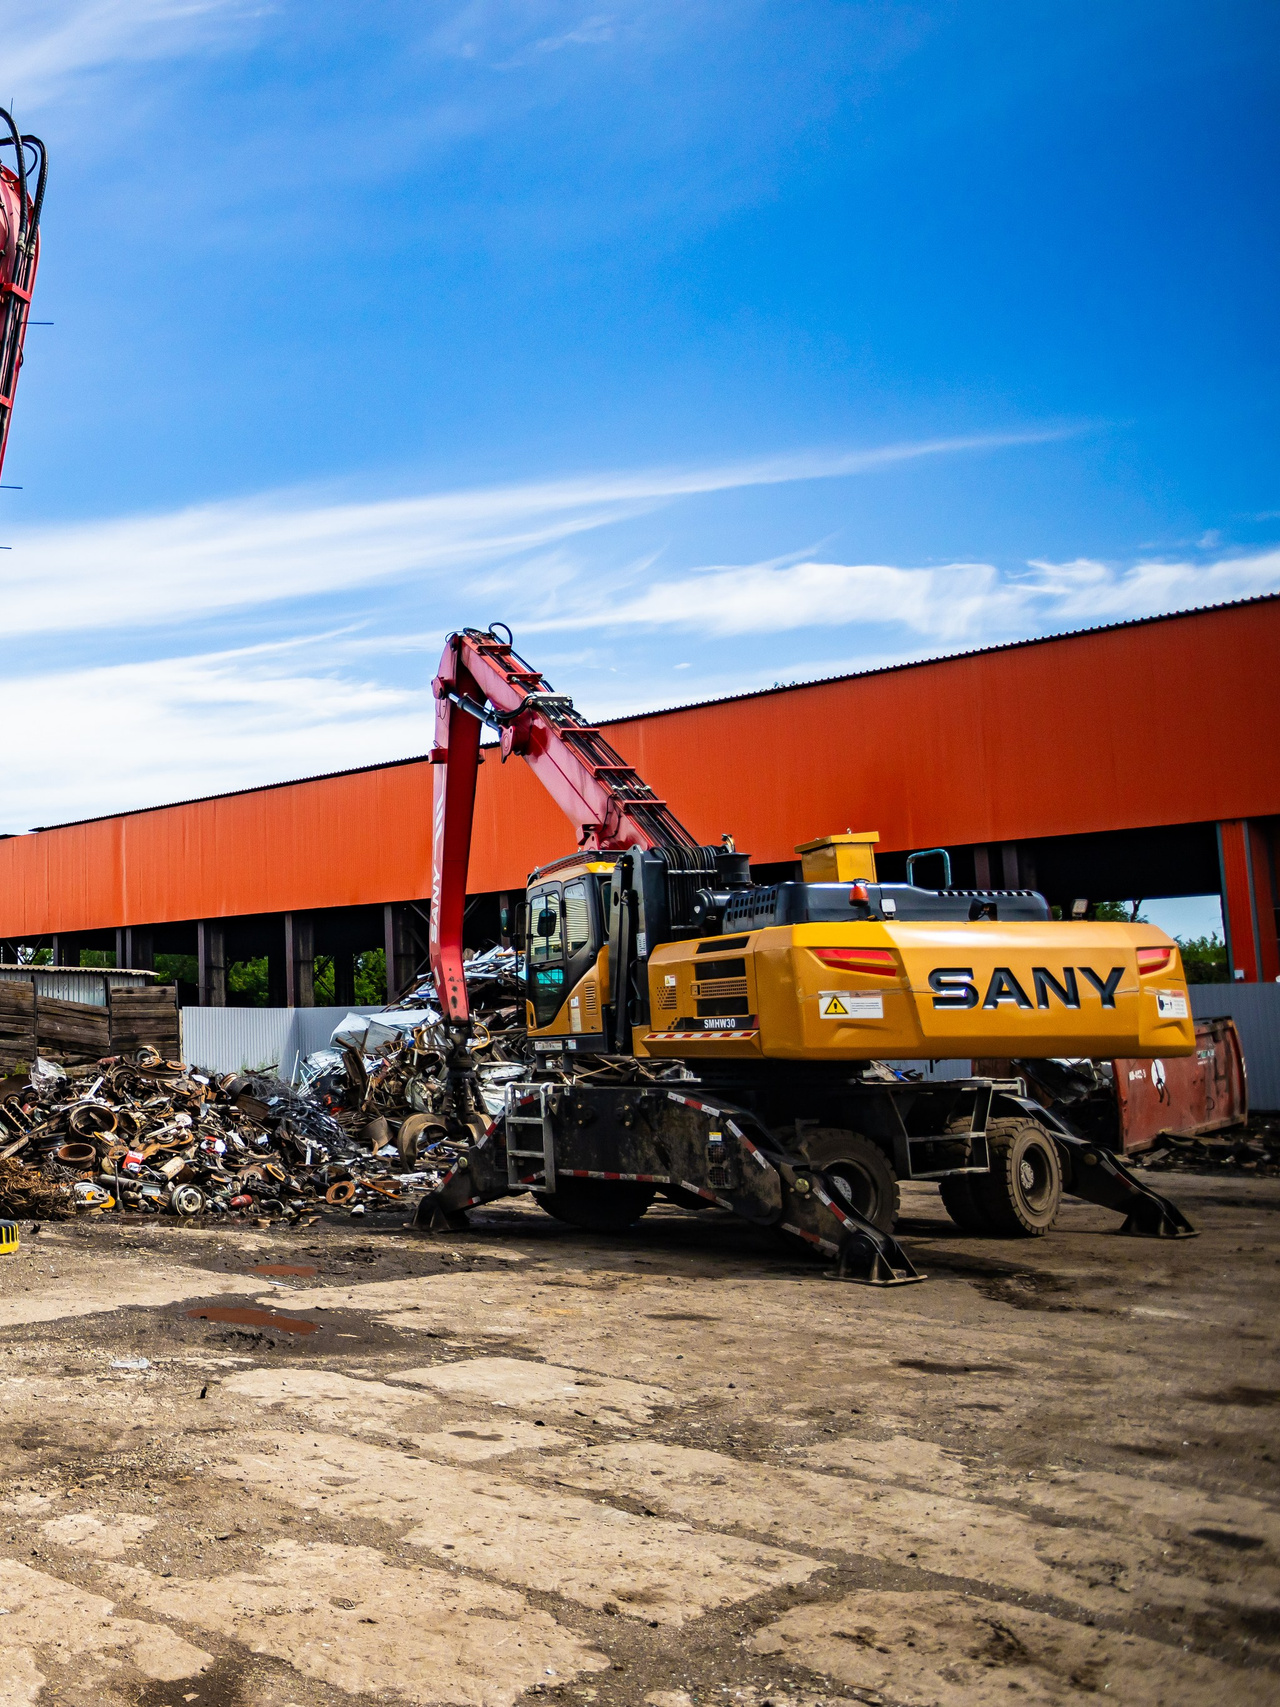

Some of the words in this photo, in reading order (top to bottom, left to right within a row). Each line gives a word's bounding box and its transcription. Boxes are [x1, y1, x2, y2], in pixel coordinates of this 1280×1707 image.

[430, 863, 441, 944] SANY
[927, 966, 1126, 1010] SANY
[703, 1017, 736, 1029] SMHW30
